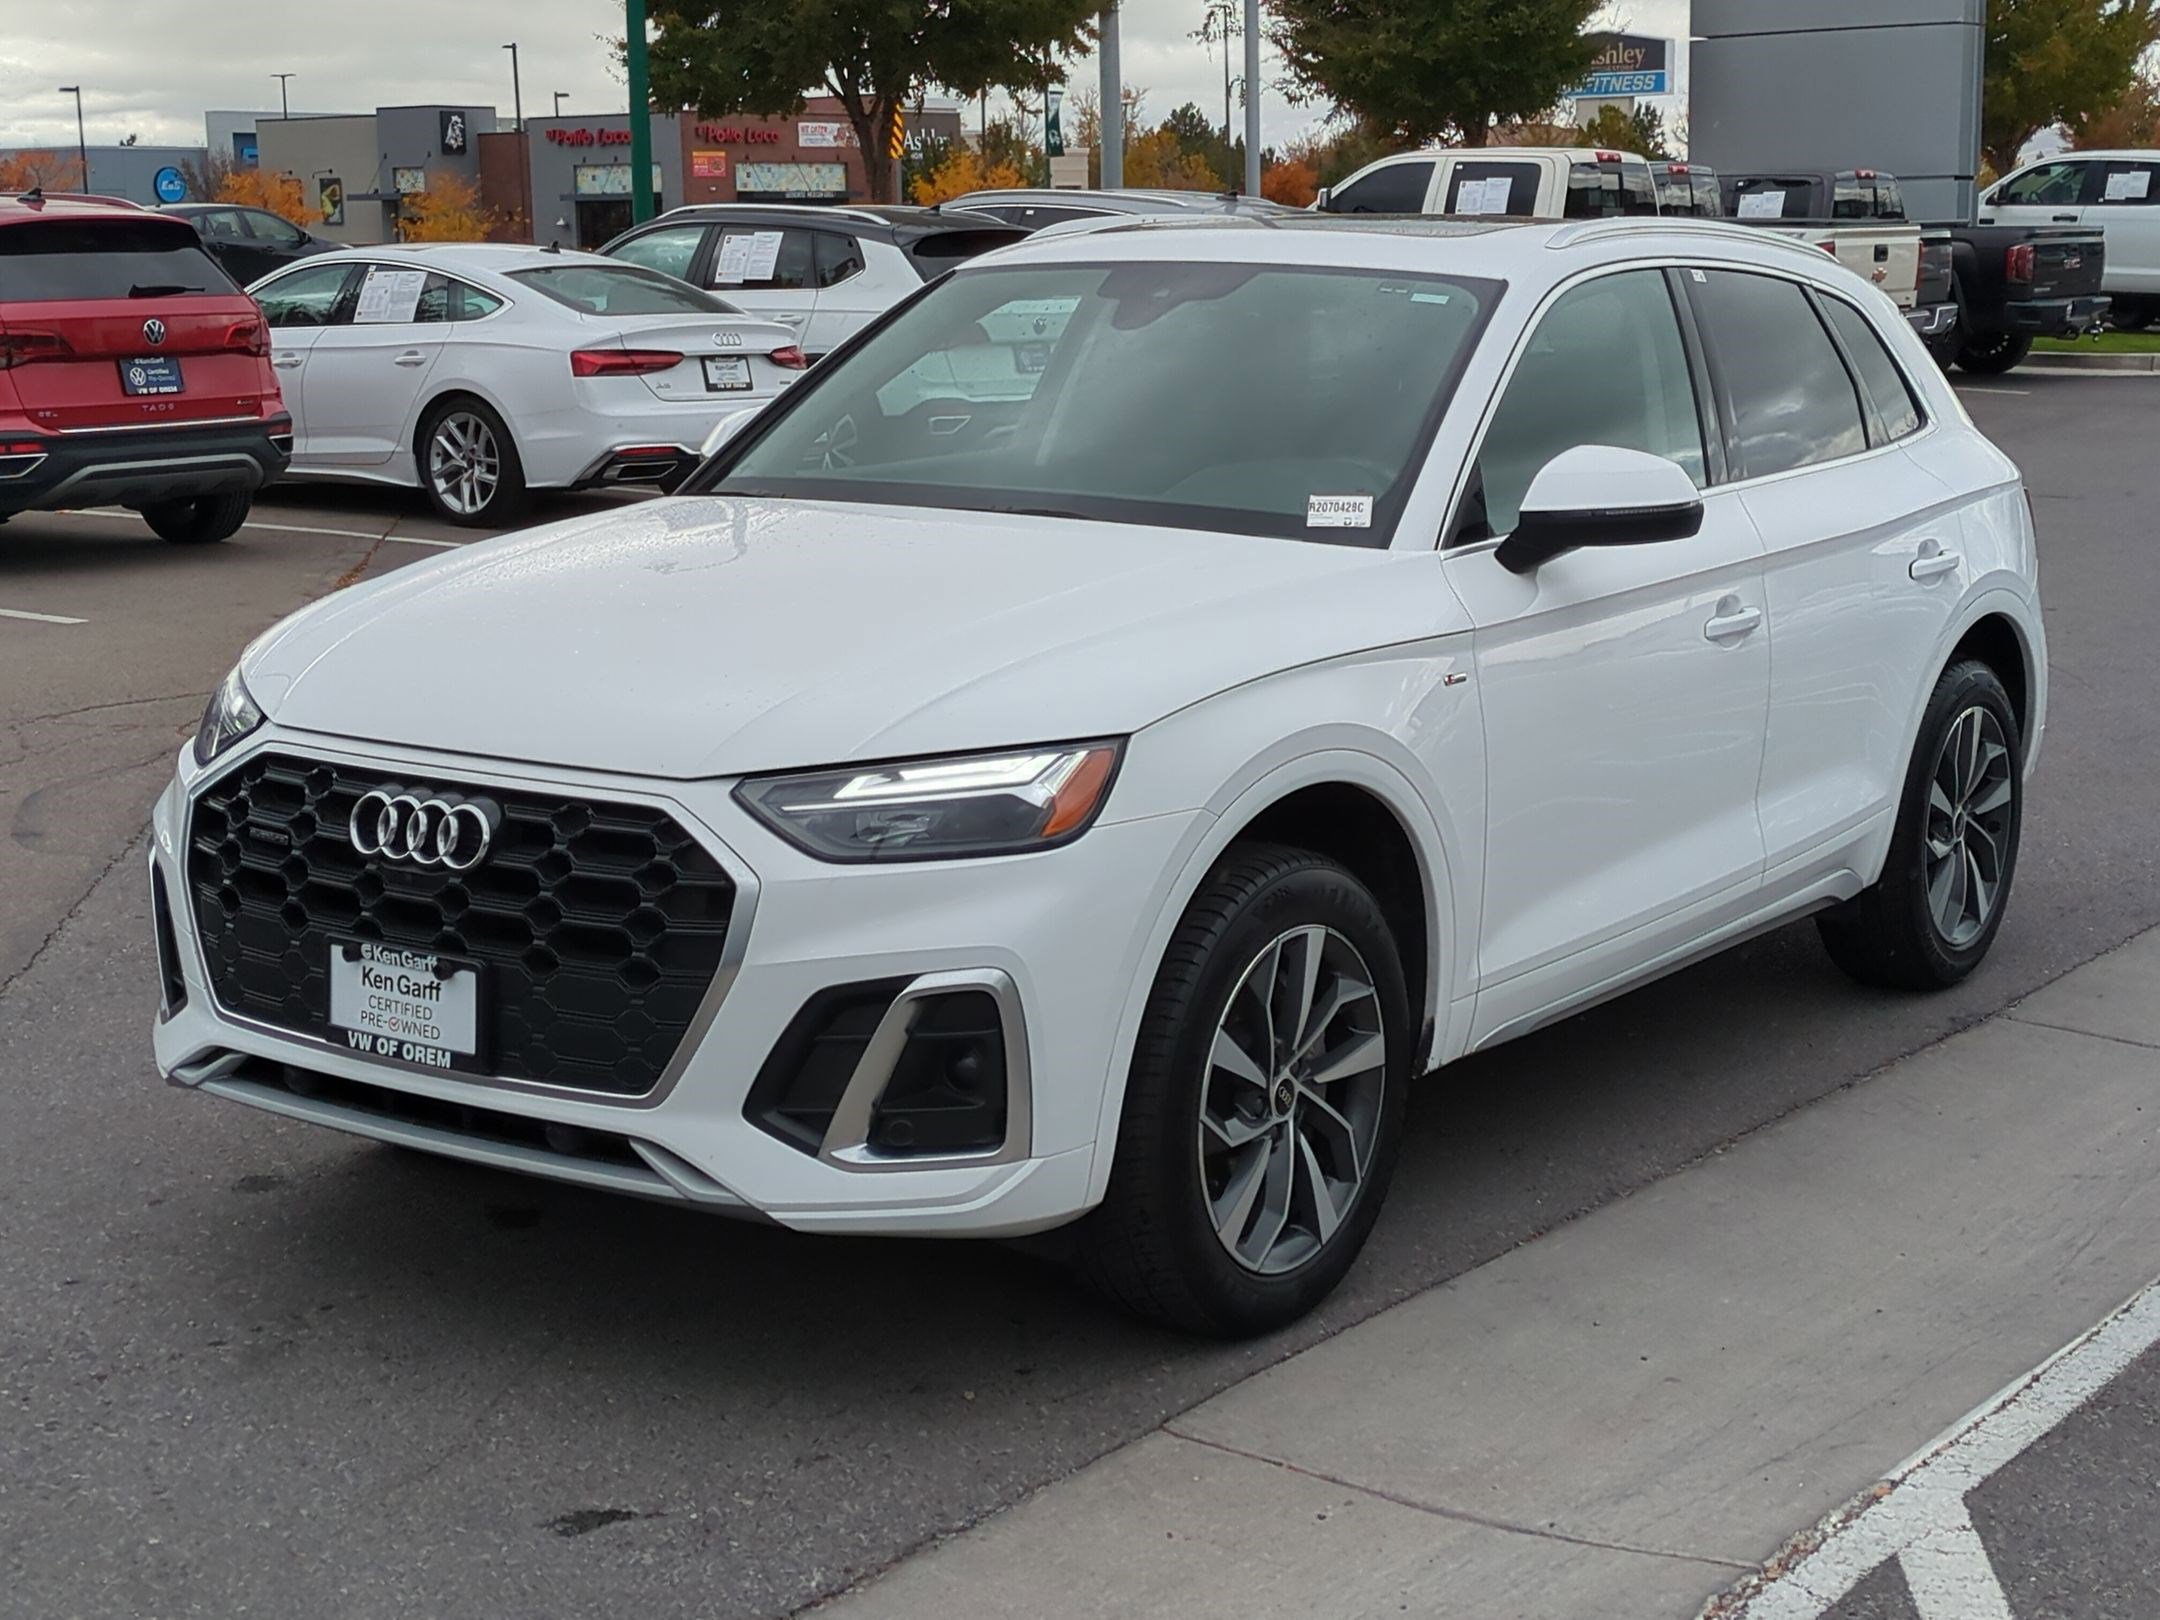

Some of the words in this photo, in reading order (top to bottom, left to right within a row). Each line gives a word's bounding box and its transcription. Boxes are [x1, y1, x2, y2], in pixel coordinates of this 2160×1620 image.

[1591, 41, 1645, 69] shley
[362, 965, 394, 992] Ken
[397, 974, 442, 1002] Garff
[368, 995, 433, 1021] CERTIFIED
[348, 1030, 373, 1052] VW
[376, 1037, 398, 1057] OF
[402, 1043, 451, 1069] OREM
